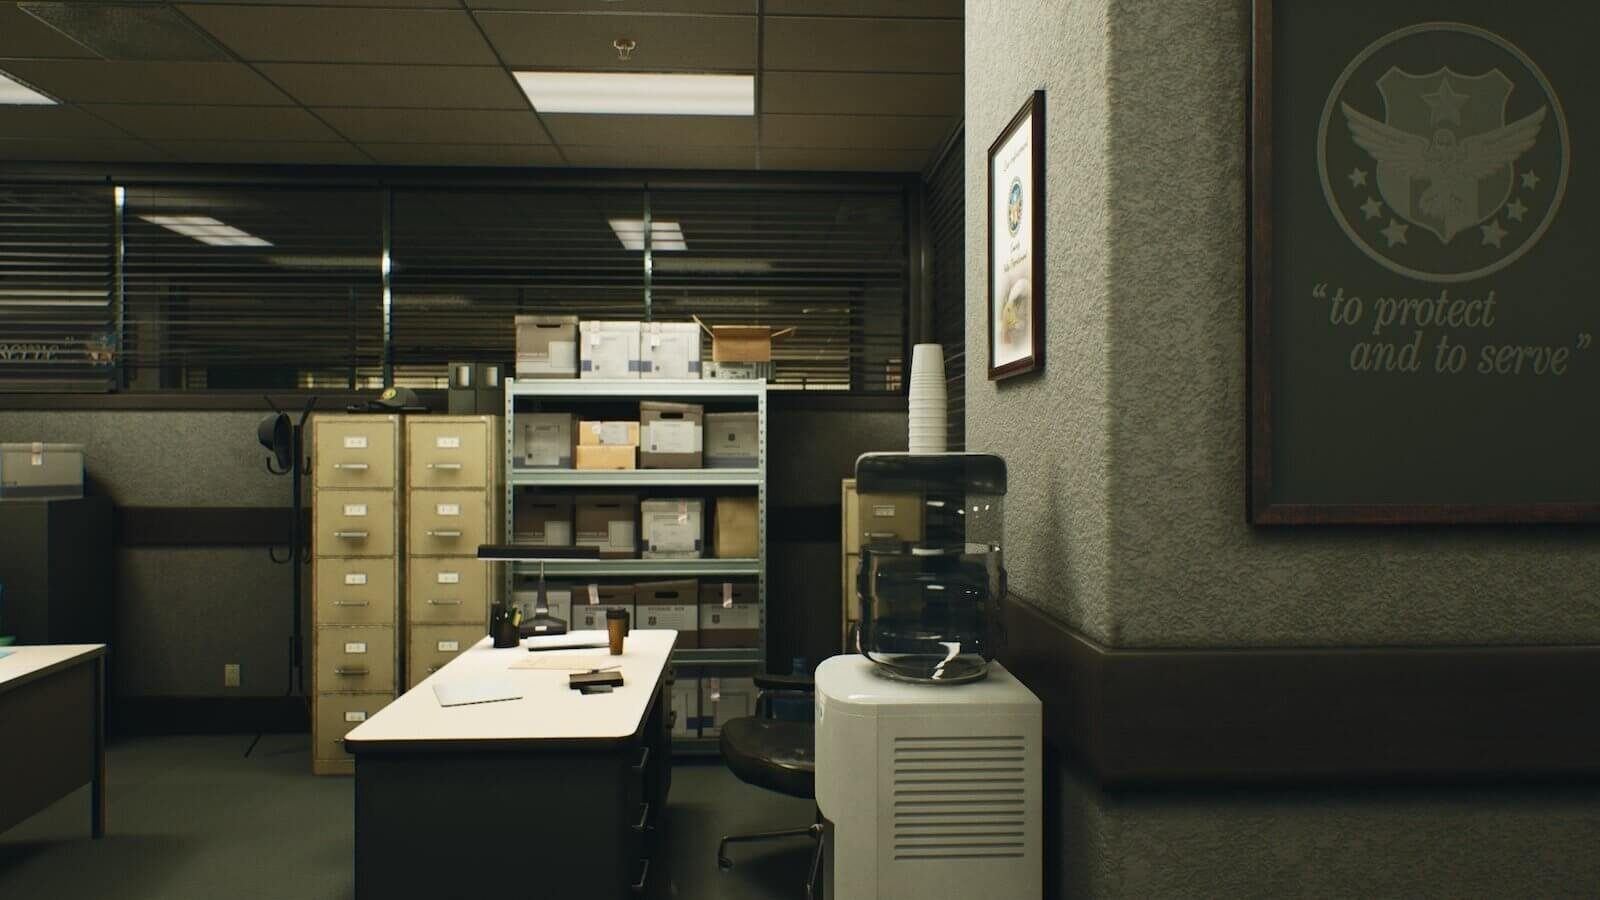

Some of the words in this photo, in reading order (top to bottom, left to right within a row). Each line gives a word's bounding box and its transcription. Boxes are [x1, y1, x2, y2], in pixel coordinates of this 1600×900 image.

[1312, 282, 1363, 326] “to
[1372, 289, 1497, 335] protect
[1350, 331, 1423, 373] and
[1434, 335, 1467, 374] to
[1477, 332, 1592, 375] serve”
